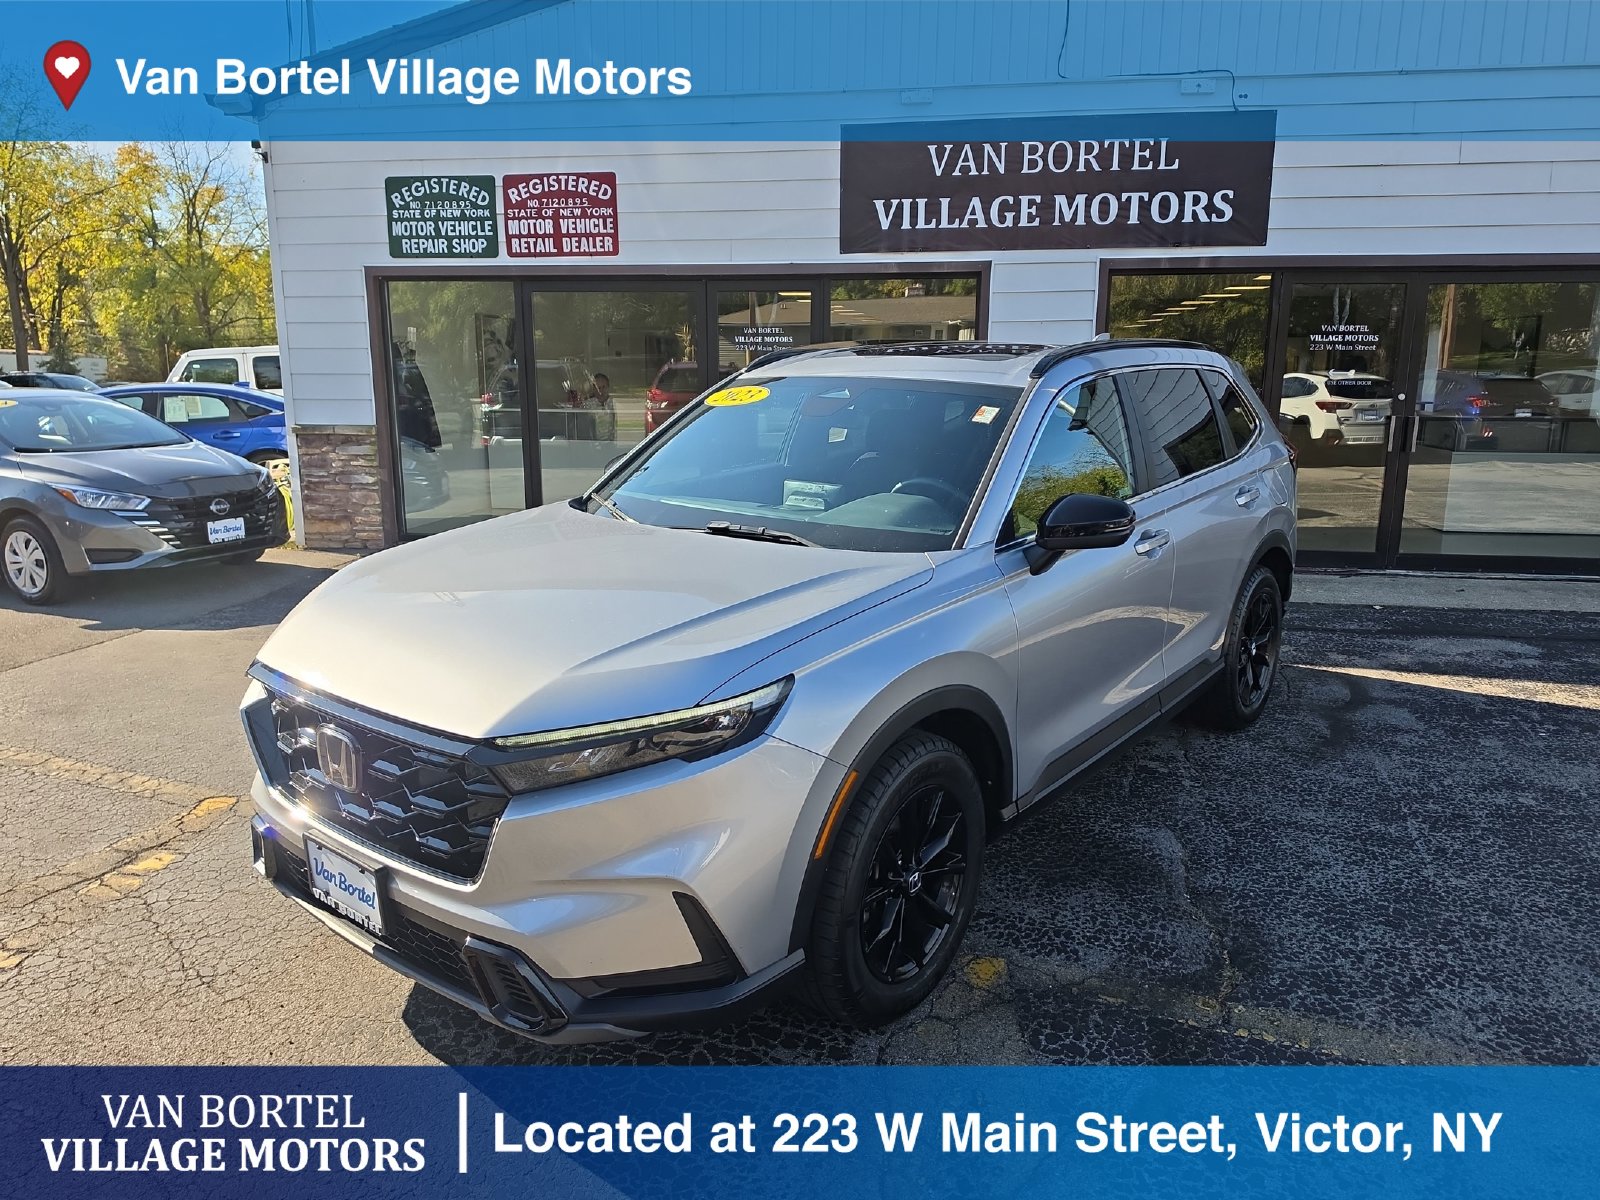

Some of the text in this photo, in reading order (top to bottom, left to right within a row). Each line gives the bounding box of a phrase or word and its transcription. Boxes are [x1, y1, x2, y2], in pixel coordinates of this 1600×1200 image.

[928, 137, 1179, 176] VAN BORTEL
[391, 177, 490, 208] REGISTERED
[507, 175, 612, 204] REGISTERED
[424, 200, 471, 209] 7120895
[542, 198, 588, 206] 7120895
[873, 190, 1234, 230] VILLAGE MOTORS
[392, 209, 490, 218] STATE OF NEW YORK
[507, 208, 613, 217] STATE OF NEW YORK
[392, 220, 493, 236] MOTOR VEHICLE
[508, 218, 614, 235] MOTOR VEHICLE
[402, 238, 487, 253] REPAIR SHOP
[511, 236, 613, 253] RETAIL DEALER
[313, 857, 375, 909] Van Bortel
